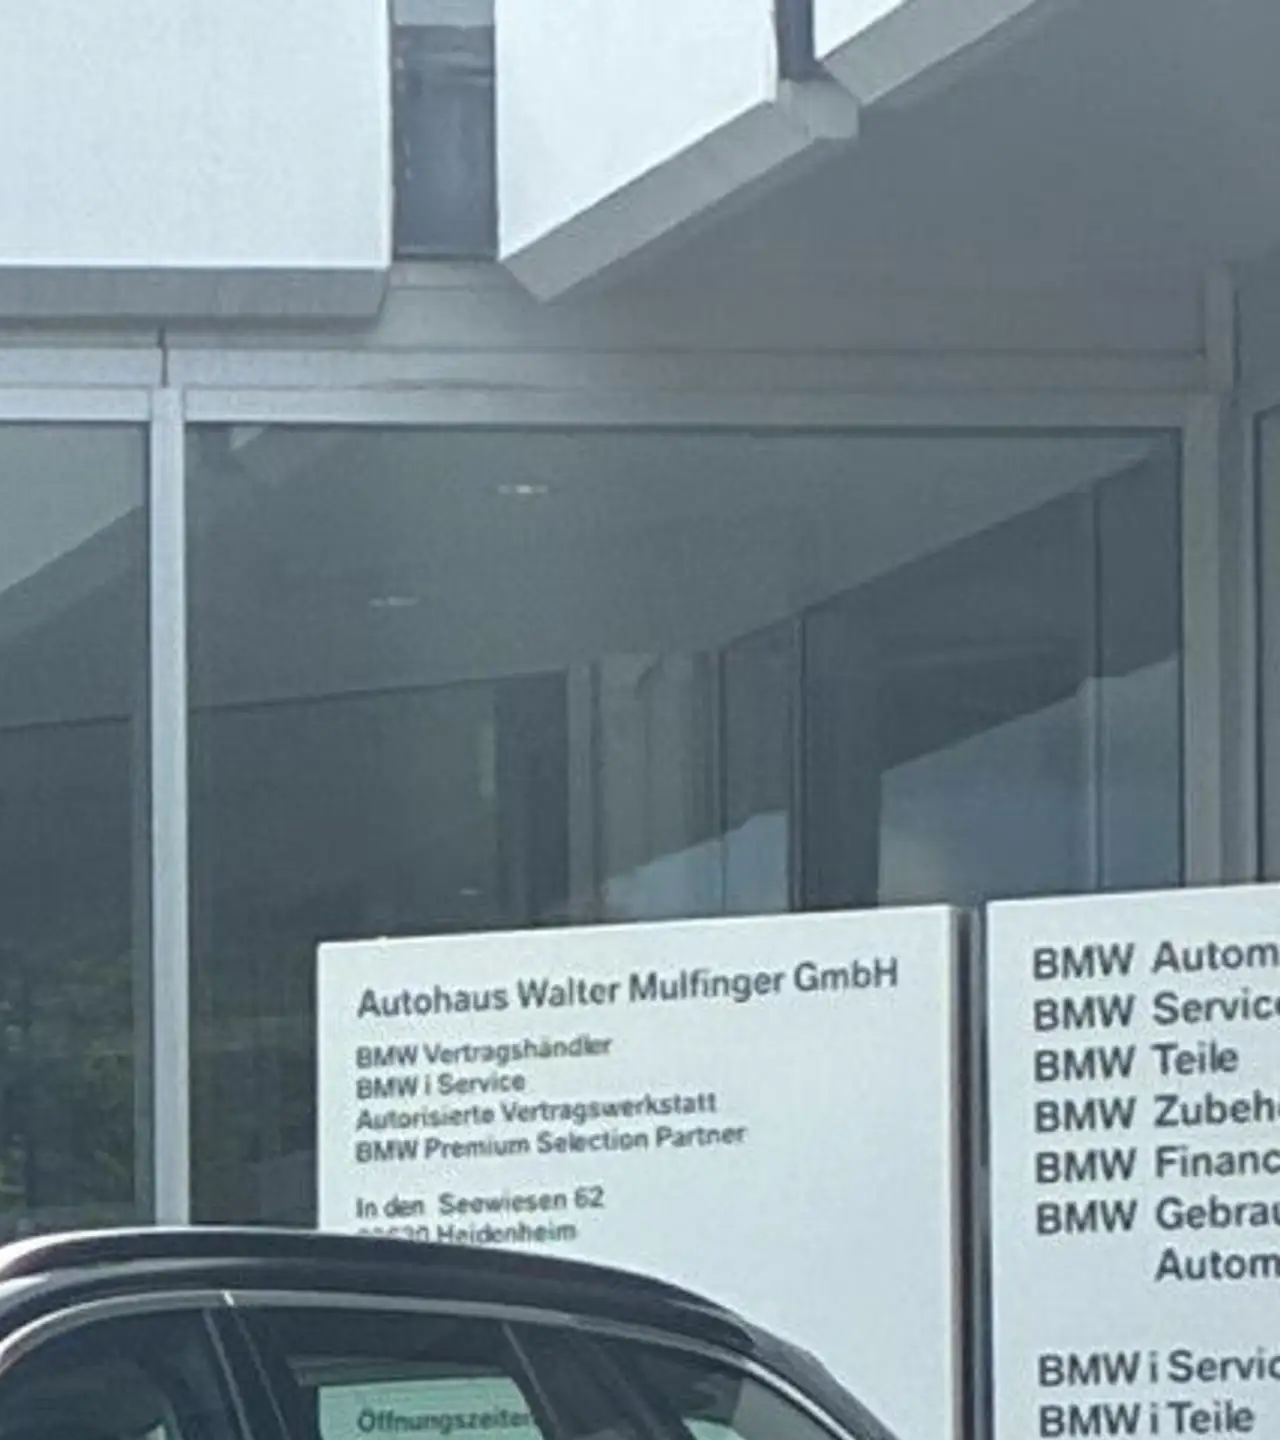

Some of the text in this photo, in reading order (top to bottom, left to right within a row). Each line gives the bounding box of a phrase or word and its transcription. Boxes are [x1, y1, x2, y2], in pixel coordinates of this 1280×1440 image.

[1033, 940, 1280, 981] BMW Autom
[356, 957, 899, 1019] Autohaus Walter Mulfinger GmbH
[1033, 986, 1280, 1032] BMW Servic
[356, 1036, 613, 1069] BMW Vertragshändler
[1034, 1039, 1240, 1083] BMW Teile
[356, 1071, 526, 1100] BMW i Service
[356, 1092, 718, 1131] Autorisierte Vertragswerkstatt
[1034, 1088, 1280, 1133] BMW Zubeh
[355, 1125, 747, 1163] BMW Premium Selection Partner
[1035, 1146, 1137, 1184] BMW
[355, 1185, 605, 1219] In den Seewiesen 62
[1036, 1198, 1138, 1236] BMW
[436, 1218, 577, 1244] Heidenheim
[1039, 1351, 1140, 1387] BMW
[1149, 1350, 1159, 1384] i
[1039, 1398, 1255, 1438] BMW i Teile
